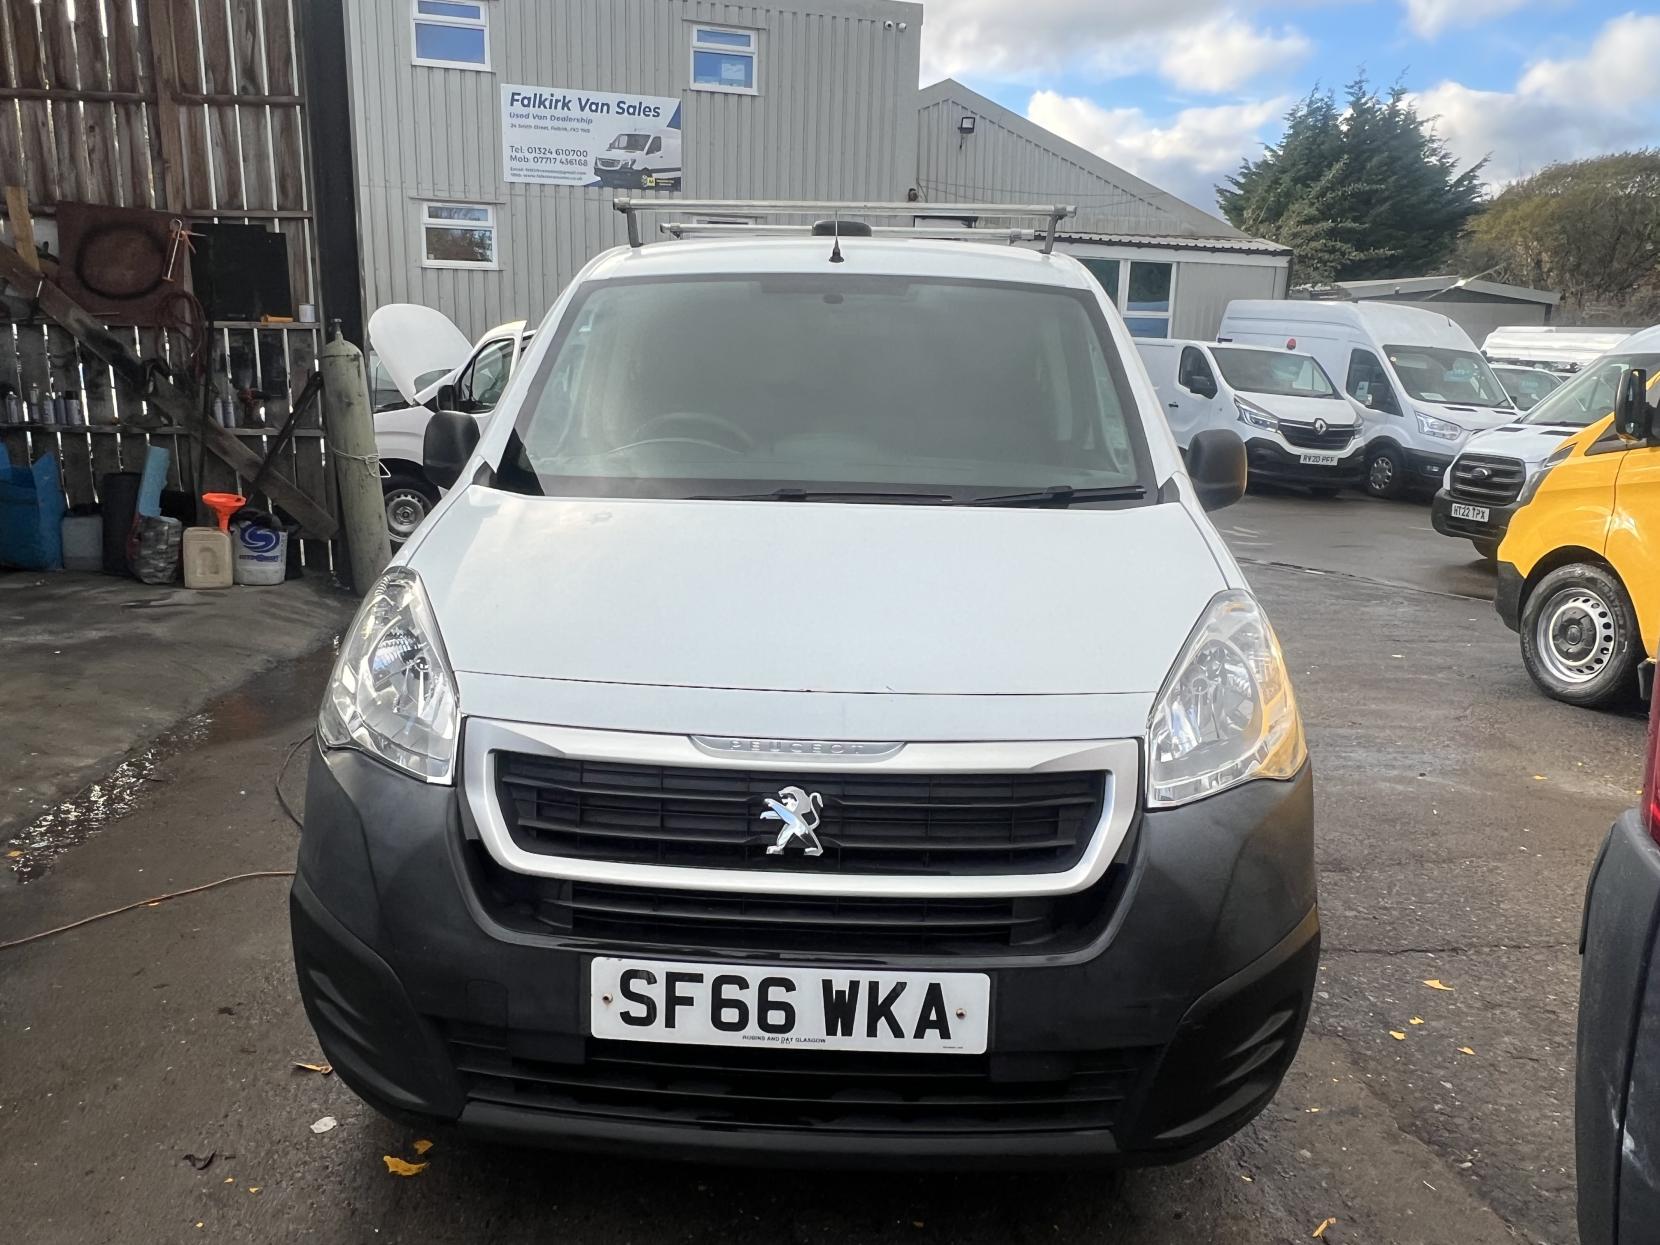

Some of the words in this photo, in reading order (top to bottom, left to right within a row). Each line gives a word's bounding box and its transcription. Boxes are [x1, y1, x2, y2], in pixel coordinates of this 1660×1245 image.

[510, 92, 573, 112] Falkirk
[577, 97, 611, 114] Van
[615, 101, 661, 118] Sales
[509, 112, 530, 120] Used
[550, 115, 593, 125] Dealership
[527, 147, 553, 155] 01324
[555, 148, 588, 157] 610700
[533, 156, 557, 165] 07717
[619, 968, 797, 1035] SF66
[821, 978, 952, 1040] WKA
